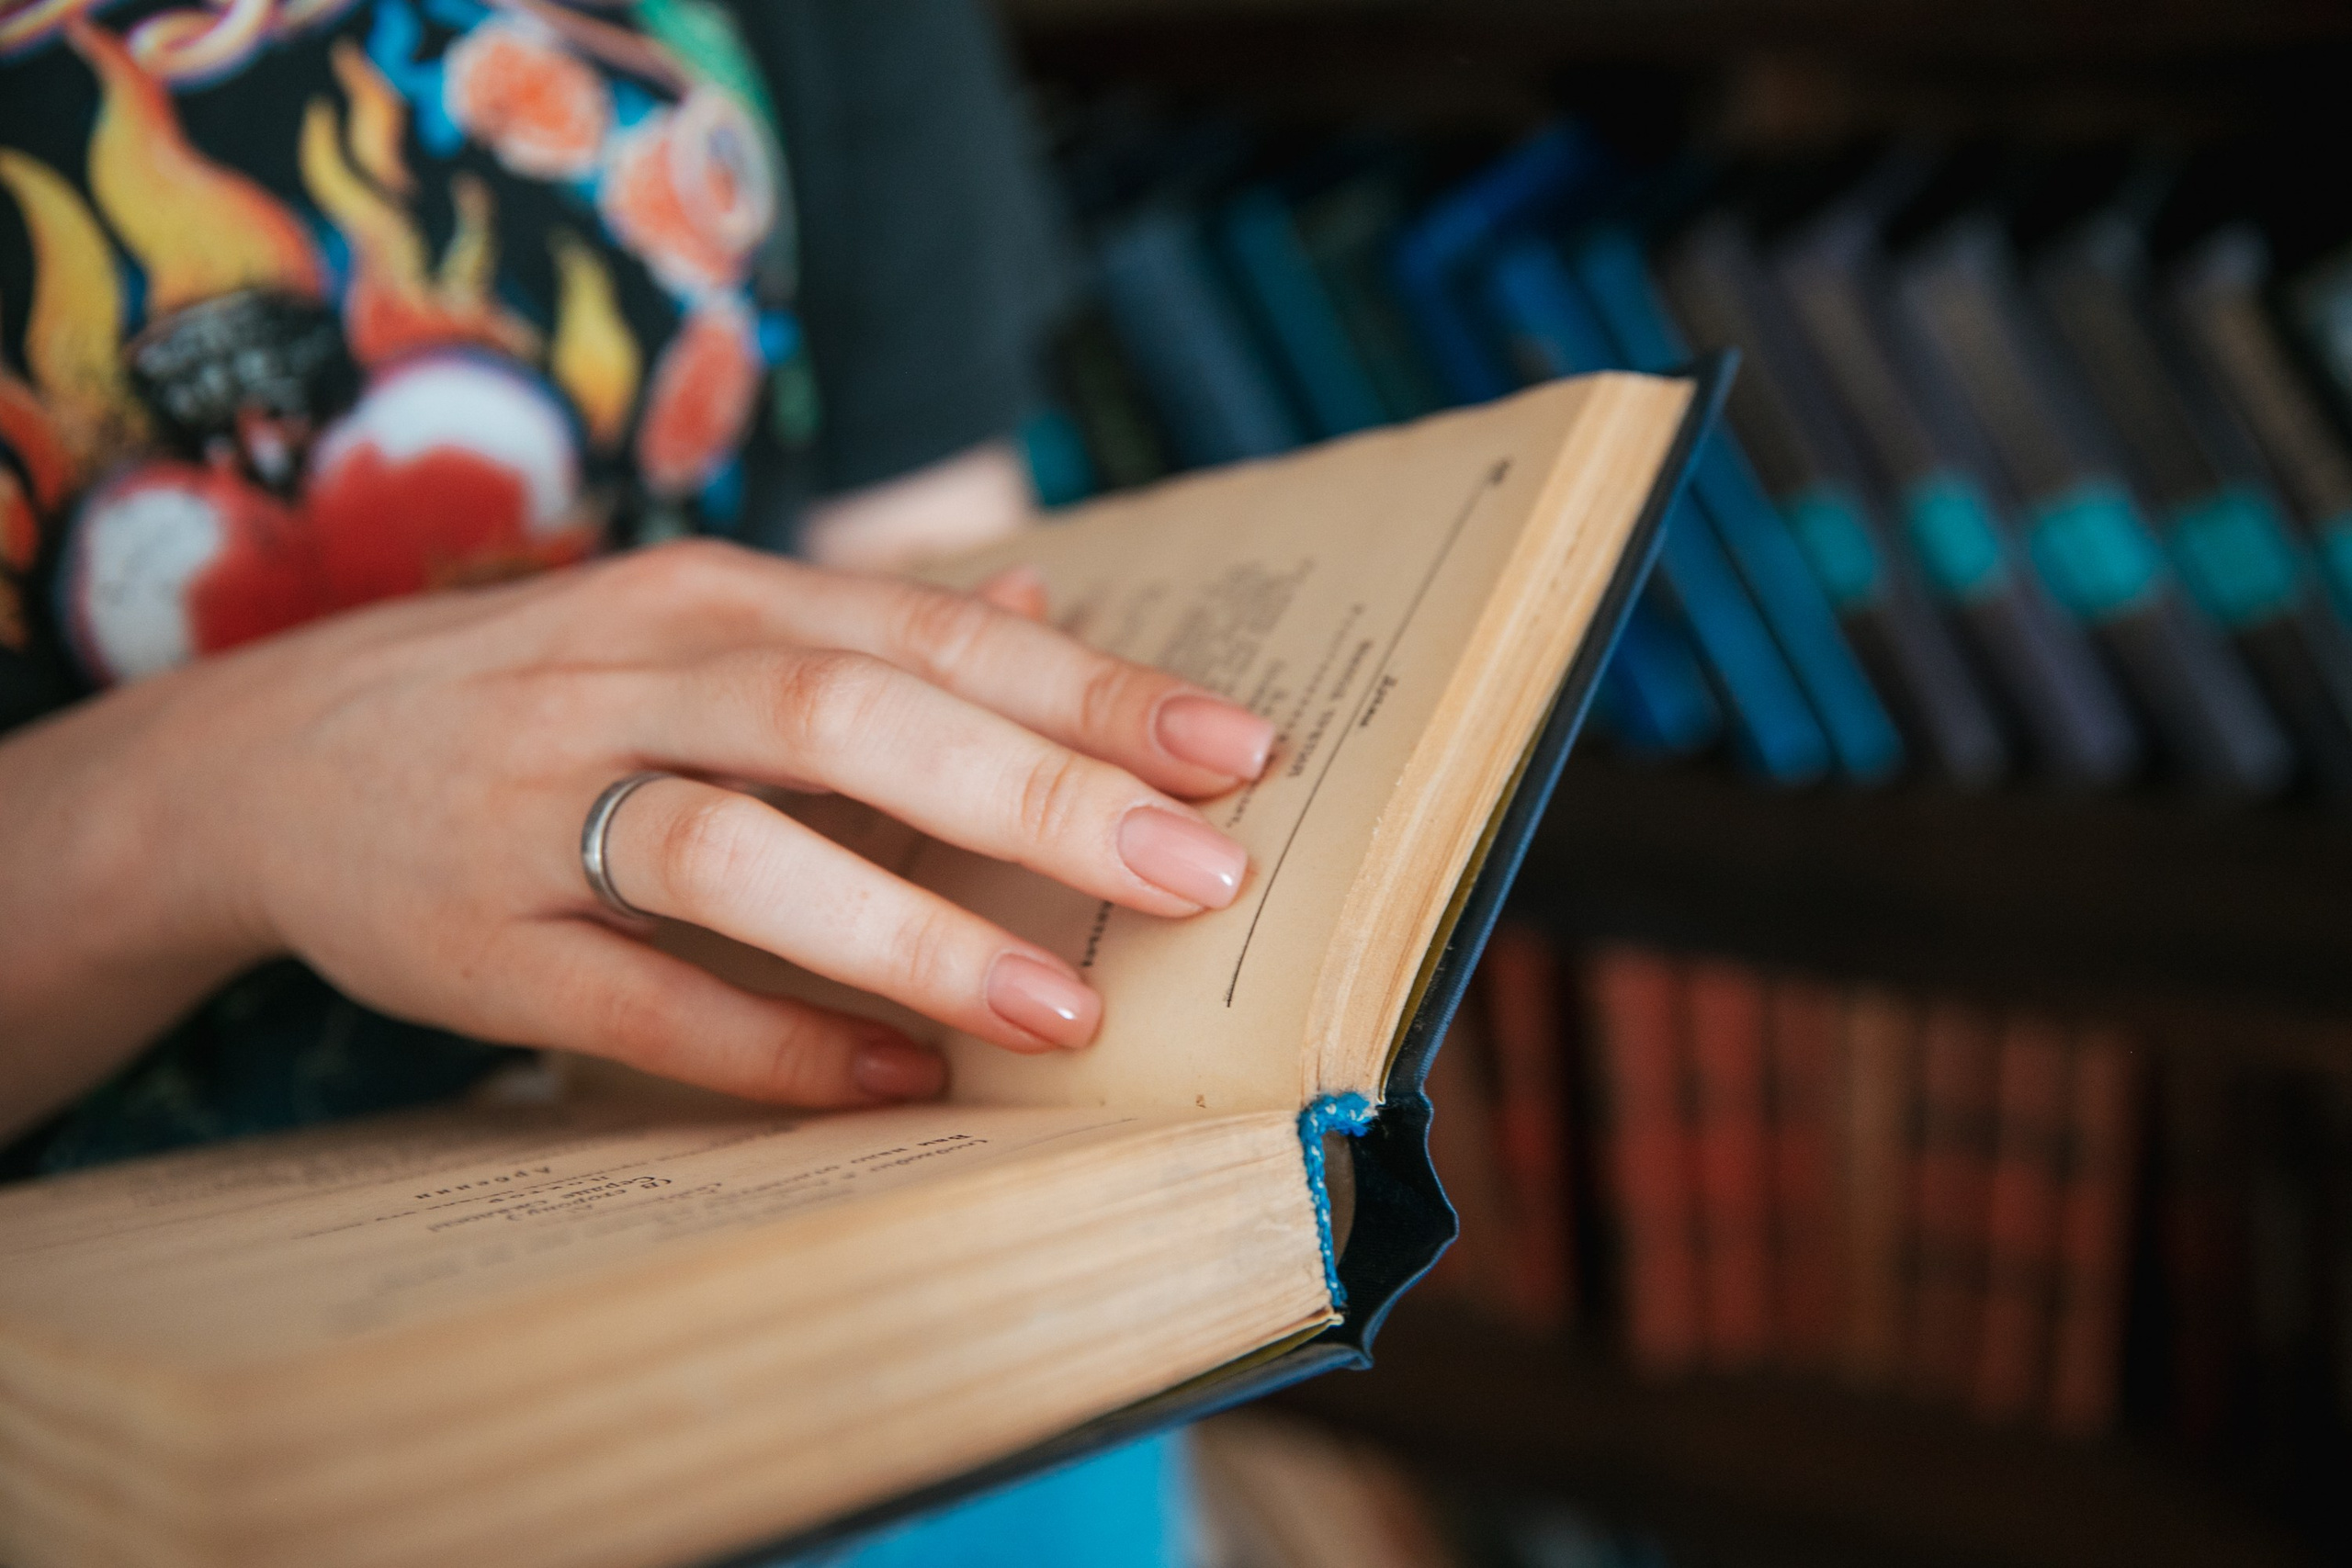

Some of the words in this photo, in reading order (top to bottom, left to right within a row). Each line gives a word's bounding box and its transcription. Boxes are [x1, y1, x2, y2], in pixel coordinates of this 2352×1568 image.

[916, 1134, 973, 1147] Вам
[413, 1167, 551, 1200] Арбенин
[488, 1176, 610, 1204] Доктор
[560, 1176, 657, 1200] Сердце
